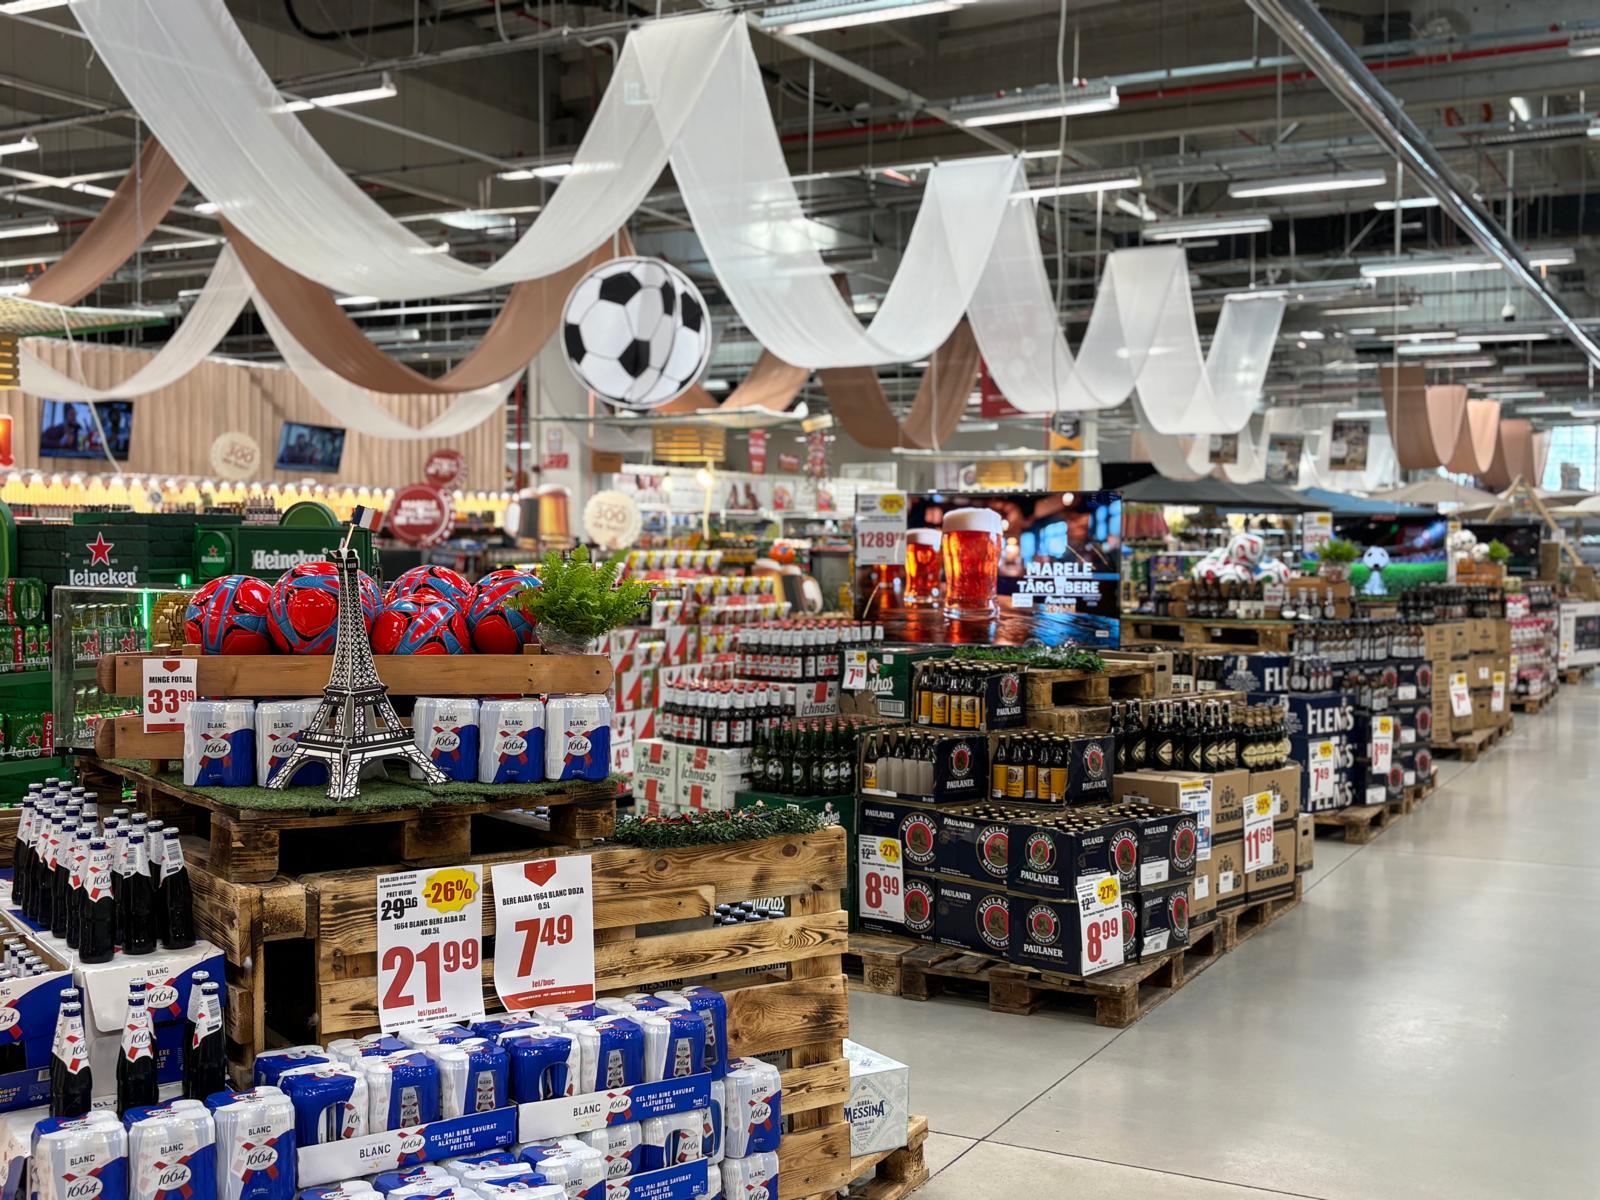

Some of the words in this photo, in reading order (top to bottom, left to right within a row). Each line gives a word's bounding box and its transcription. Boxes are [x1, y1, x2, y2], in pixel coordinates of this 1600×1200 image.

[252, 549, 327, 570] Heineken
[1026, 562, 1093, 576] MARELE
[1064, 581, 1100, 593] BERE
[149, 676, 169, 684] MINGE
[171, 676, 193, 684] FOTBAL
[207, 720, 226, 728] BLANC
[274, 720, 293, 728] BLANC
[203, 739, 228, 754] 1664
[435, 735, 458, 746] 1664
[502, 740, 525, 750] 1664
[568, 740, 590, 750] 1664
[946, 779, 975, 789] PAULANER
[865, 808, 895, 820] PAULANER
[901, 815, 937, 835] PAULANER
[943, 818, 975, 829] PAULANER
[1021, 870, 1059, 885] PAULANER
[424, 878, 472, 903] -26%
[865, 871, 900, 909] 899
[941, 888, 971, 900] PAULANER
[502, 897, 517, 906] BERE
[518, 894, 532, 904] ALBA
[533, 892, 548, 901] 1664
[549, 889, 567, 898] BLANC
[537, 902, 550, 910] 0.5L
[394, 922, 408, 930] 1664
[409, 920, 428, 928] BLANC
[444, 915, 458, 924] ALBA
[515, 914, 573, 977] 749
[1087, 917, 1118, 962] 899
[1023, 943, 1063, 958] PAULANER
[147, 967, 169, 976] BLANC
[148, 990, 175, 1004] 1664
[672, 1087, 695, 1096] SAVURAT
[573, 1103, 601, 1116] BLANC
[610, 1099, 629, 1109] 1664
[653, 1103, 675, 1112] PRIETENI
[751, 1107, 769, 1119] 1664
[844, 1100, 885, 1123] MESSINA
[248, 1125, 272, 1136] BLANC
[472, 1123, 497, 1134] SAVURAT
[160, 1143, 184, 1154] BLANC
[401, 1139, 422, 1150] 1664
[450, 1141, 476, 1151] PRIETENI
[608, 1140, 627, 1149] BLANC
[246, 1150, 276, 1165] 1664
[359, 1144, 391, 1159] BLANC
[70, 1154, 96, 1166] BLANC
[607, 1162, 628, 1176] 1664
[158, 1169, 188, 1186] 1664
[646, 1182, 655, 1190] MAI
[670, 1174, 692, 1184] SAVURAT
[67, 1182, 100, 1198] 1664
[565, 1179, 582, 1189] BLANC
